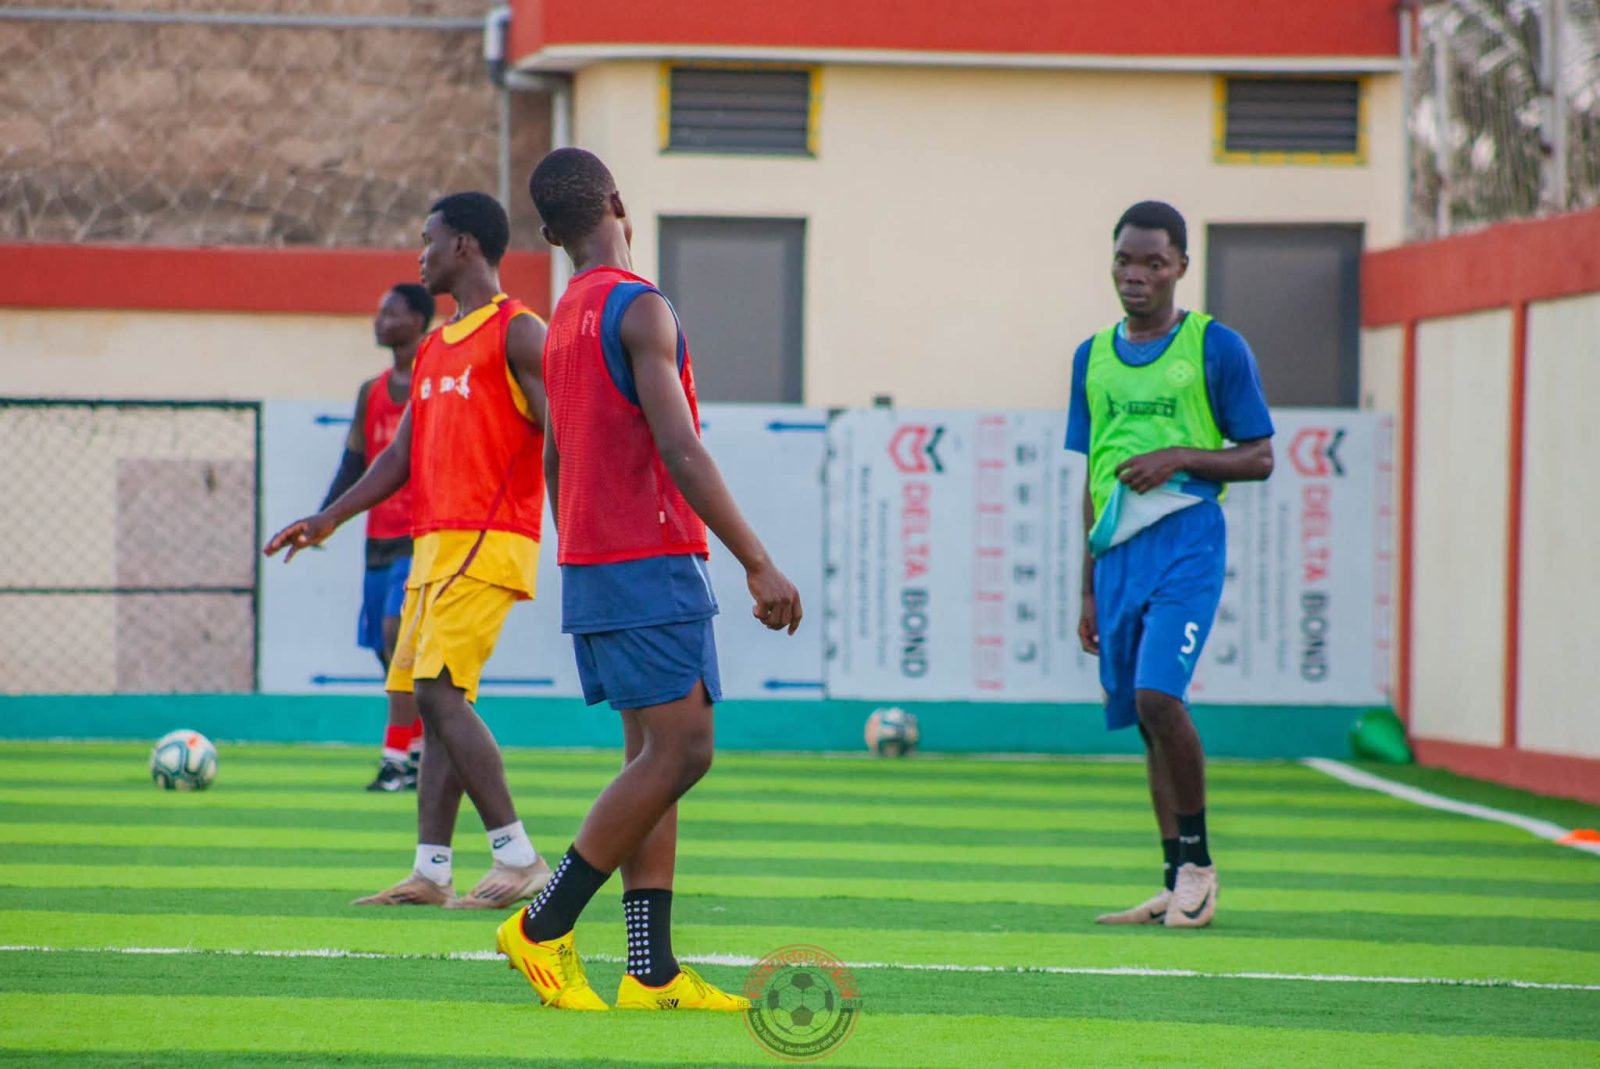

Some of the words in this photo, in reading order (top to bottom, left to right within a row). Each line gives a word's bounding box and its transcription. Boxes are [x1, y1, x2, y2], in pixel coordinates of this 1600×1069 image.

[903, 482, 931, 580] DELTA
[1302, 484, 1331, 583] DELTA
[902, 588, 929, 678] BOND
[1301, 591, 1328, 683] BOND
